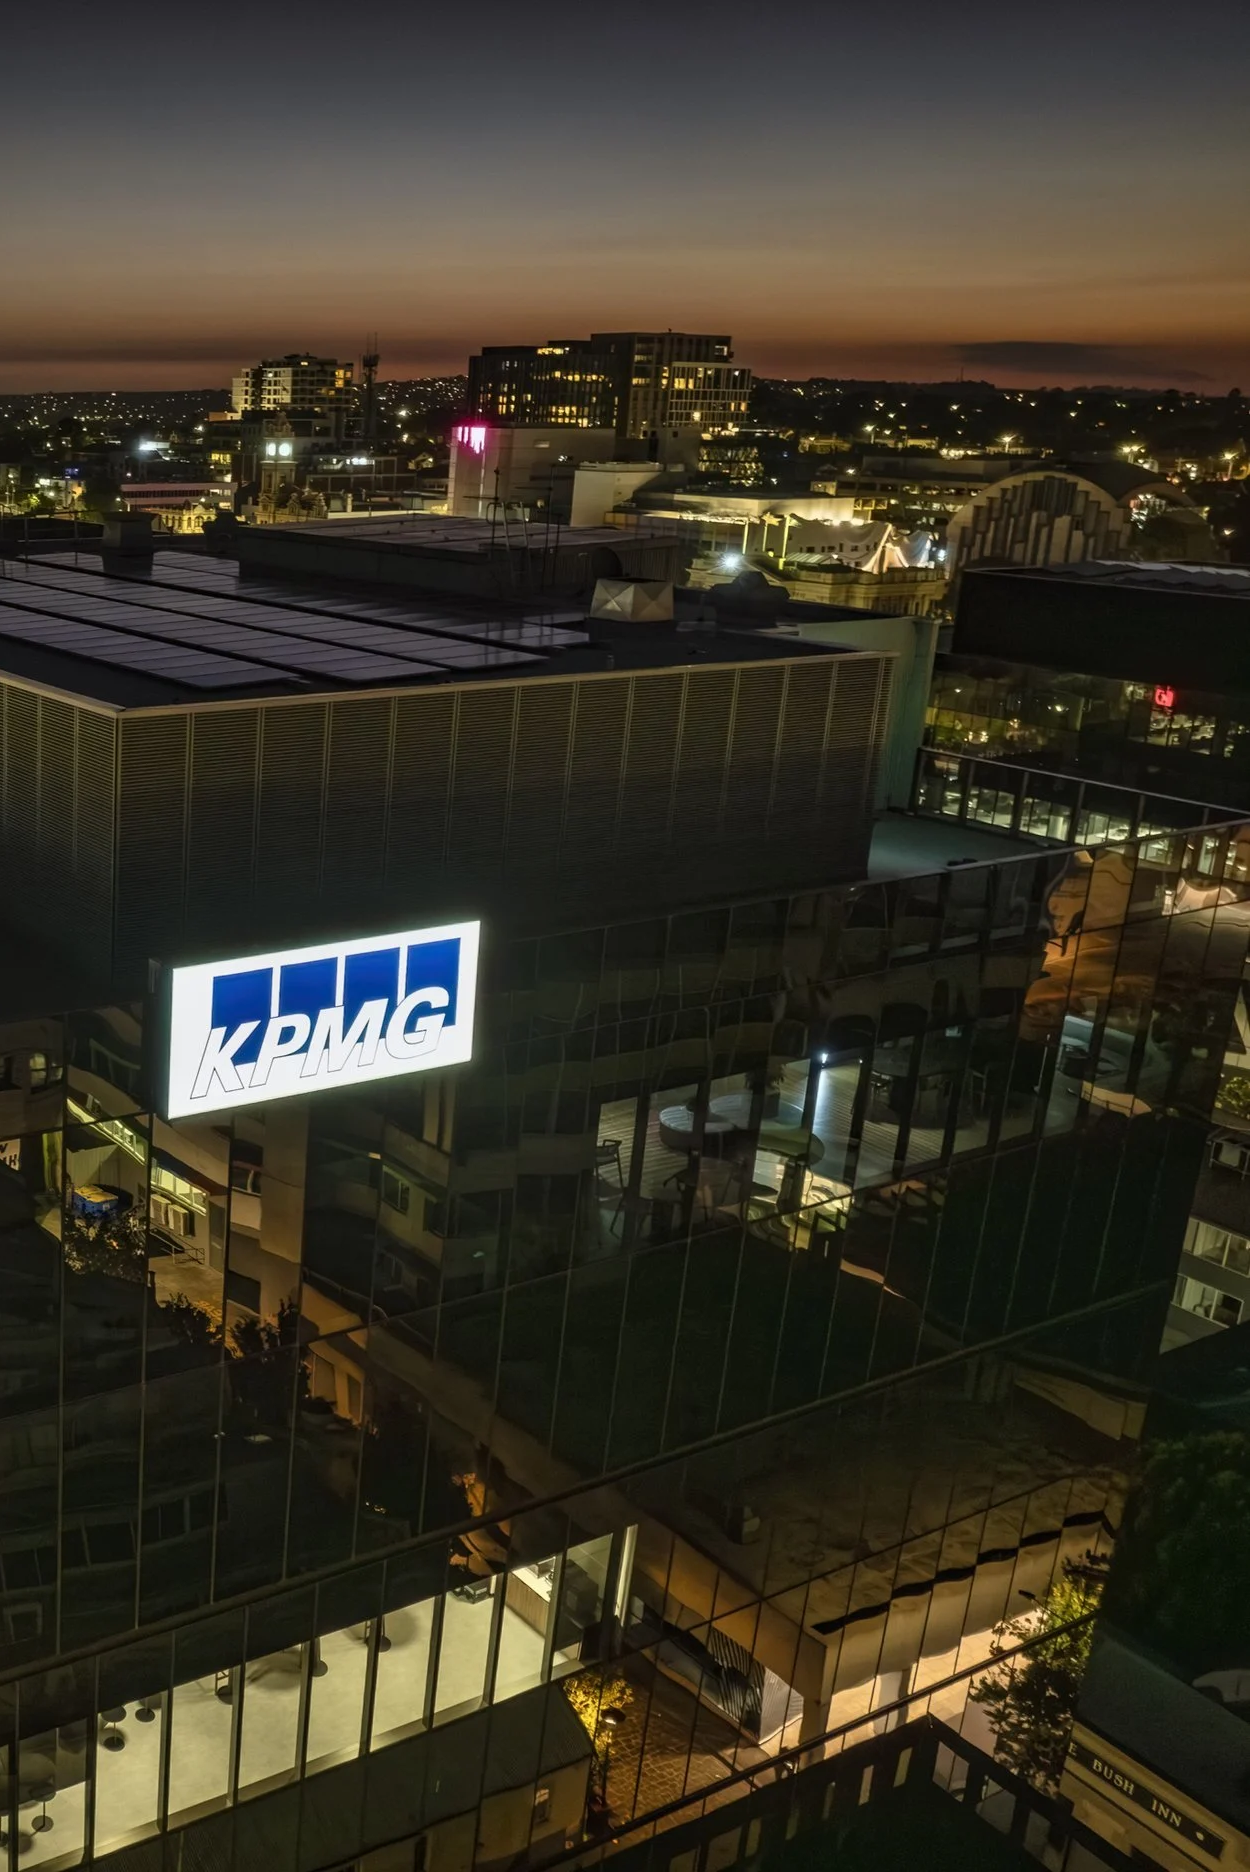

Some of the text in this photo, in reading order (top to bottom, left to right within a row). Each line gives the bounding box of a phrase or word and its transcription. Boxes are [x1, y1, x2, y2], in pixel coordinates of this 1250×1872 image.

[190, 986, 449, 1100] KPMG
[1092, 1758, 1135, 1796] BUSH
[1151, 1799, 1182, 1828] INN
